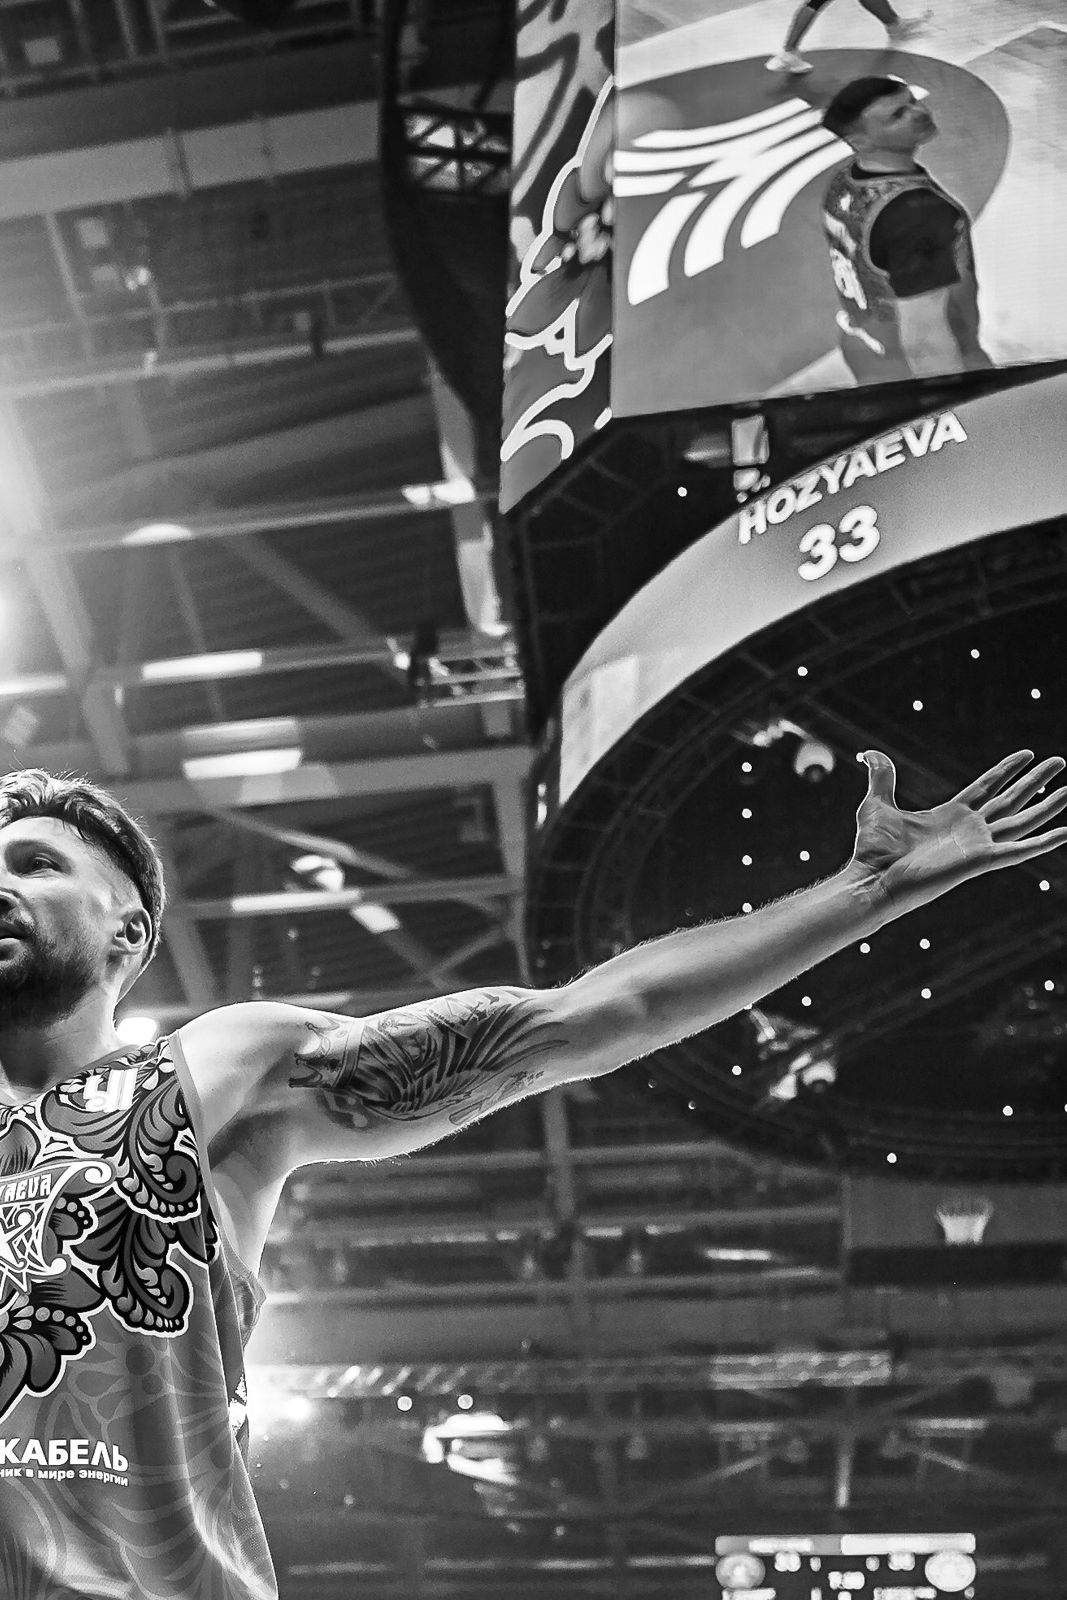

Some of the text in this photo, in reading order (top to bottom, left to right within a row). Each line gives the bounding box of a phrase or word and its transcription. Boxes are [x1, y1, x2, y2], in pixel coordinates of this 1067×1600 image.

[738, 410, 968, 545] HOZYAEVA
[797, 504, 882, 582] 33
[25, 1468, 34, 1478] в
[37, 1469, 75, 1482] мире
[78, 1469, 129, 1487] энергии
